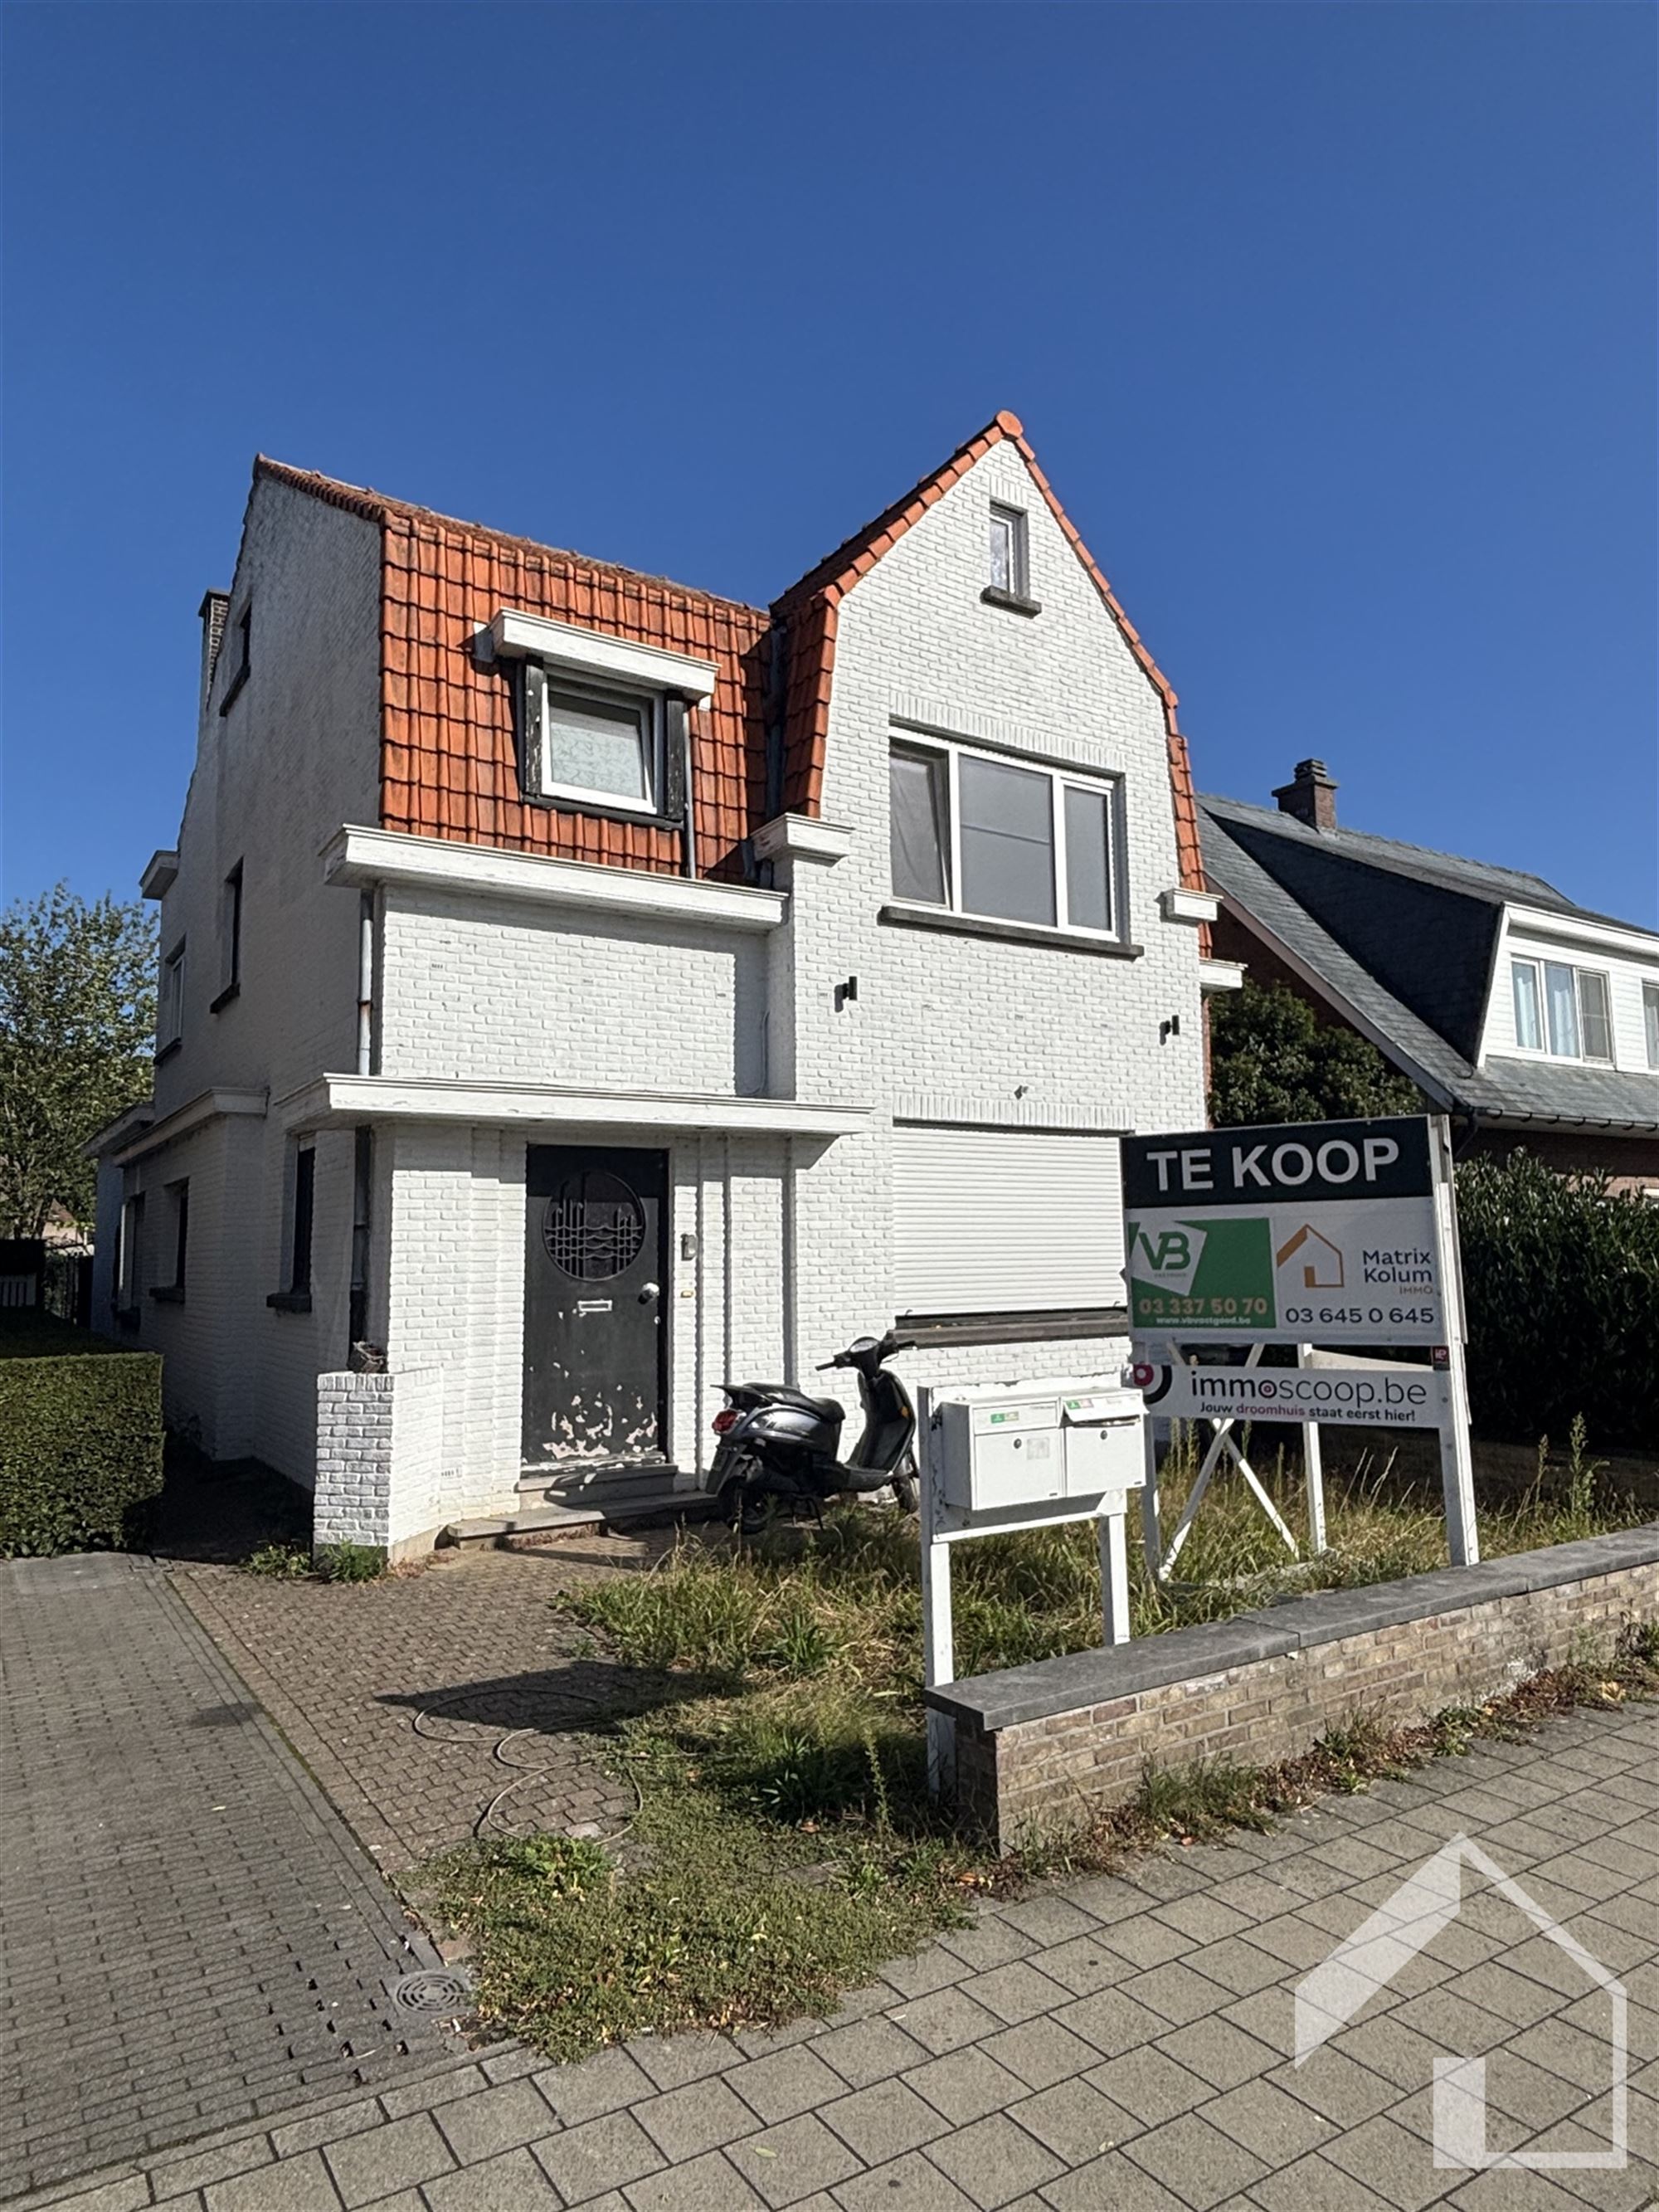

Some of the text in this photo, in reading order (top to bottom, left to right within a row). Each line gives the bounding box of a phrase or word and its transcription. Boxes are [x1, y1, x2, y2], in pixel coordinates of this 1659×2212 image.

[1146, 1138, 1399, 1191] TE KOOP
[1139, 1231, 1191, 1270] VB
[1363, 1248, 1431, 1265] Matrix
[1365, 1267, 1433, 1283] Kolum
[1399, 1285, 1433, 1294] IMMO
[1139, 1297, 1267, 1315] 03 337 50 70
[1286, 1308, 1434, 1323] 03 645 0 645
[1190, 1370, 1427, 1409] immoscoop.be
[1200, 1402, 1415, 1421] Jouw droomhuis staat eerst hier!
